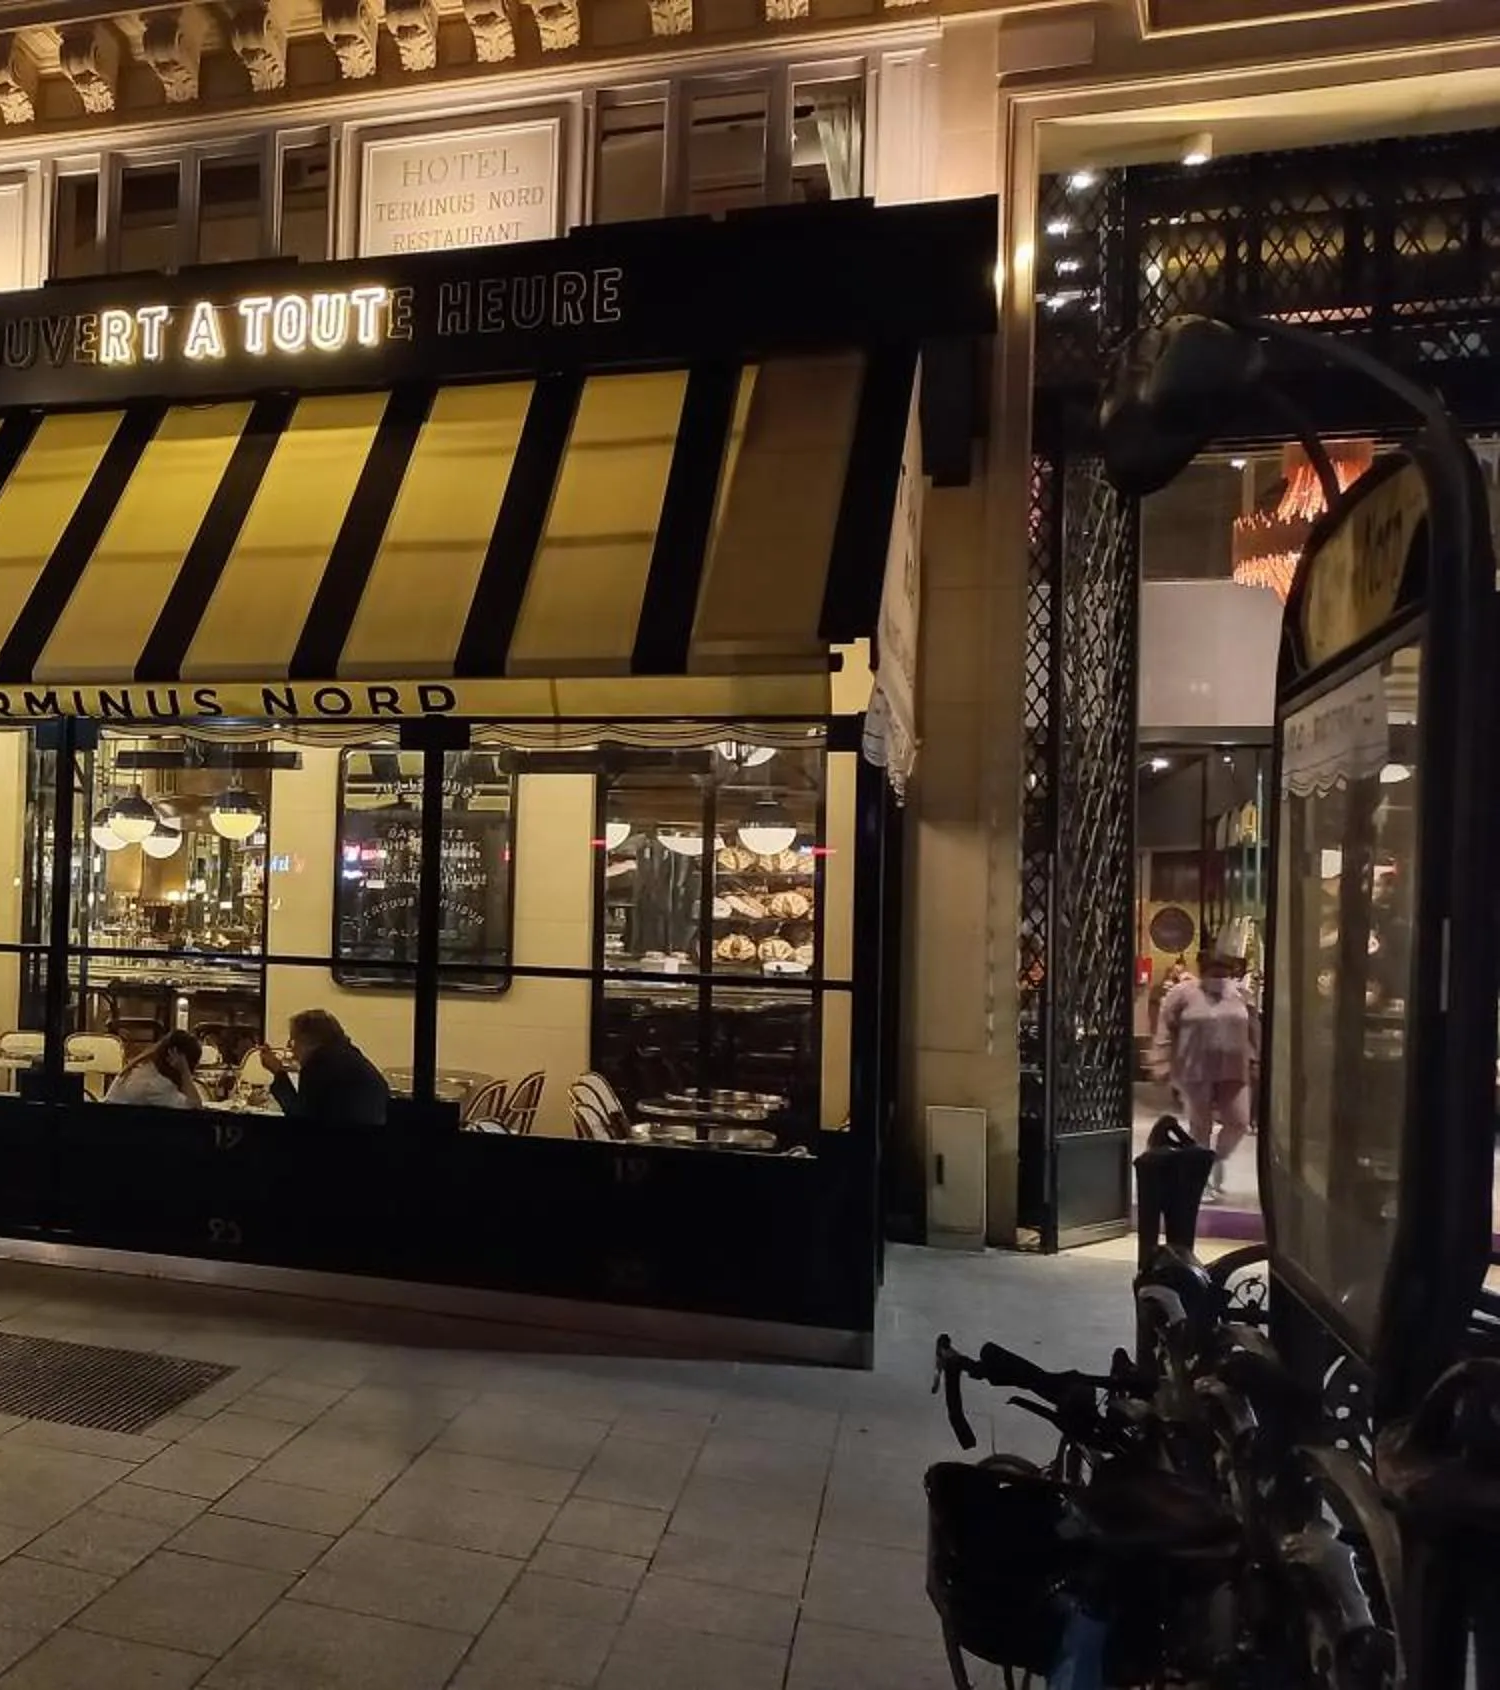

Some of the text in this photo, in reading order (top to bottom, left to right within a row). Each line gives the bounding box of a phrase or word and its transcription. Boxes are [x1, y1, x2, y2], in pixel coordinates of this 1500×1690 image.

[402, 147, 520, 188] HOTEL
[374, 185, 545, 223] TERMINUS NORD
[393, 221, 523, 251] RESTAURANT
[183, 300, 227, 360] A
[238, 284, 415, 355] TOUTE
[437, 267, 624, 337] HEURE
[262, 684, 457, 716] NORD
[214, 1124, 243, 1149] 19
